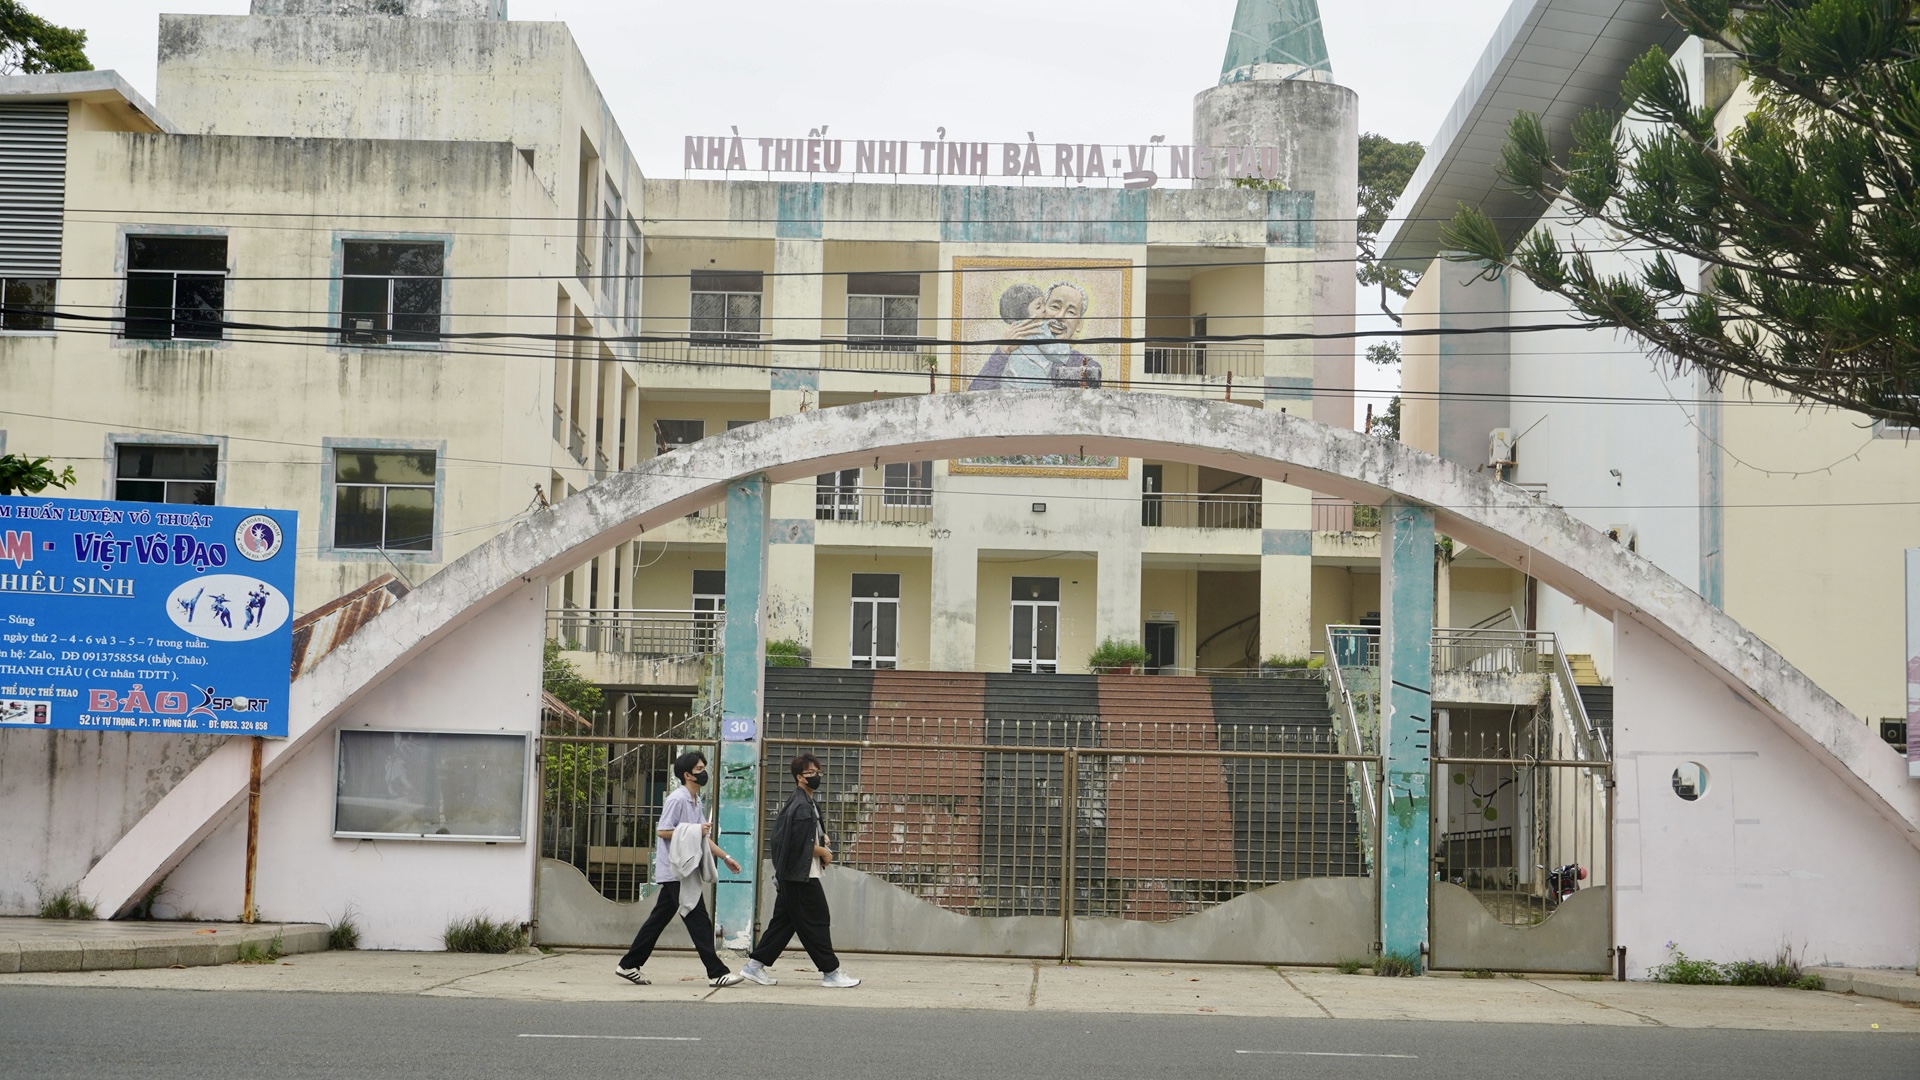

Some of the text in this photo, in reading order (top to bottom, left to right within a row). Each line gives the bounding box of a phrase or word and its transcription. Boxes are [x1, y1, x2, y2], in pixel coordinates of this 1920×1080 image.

[685, 125, 746, 170] NHÀ
[758, 125, 841, 173] THIẾU
[856, 139, 907, 174] NHI
[920, 126, 988, 175] TỈNH
[1002, 131, 1042, 177] BÀ
[16, 502, 64, 520] HUẤN
[68, 507, 124, 525] LUYỆN
[128, 509, 151, 524] VÕ
[156, 511, 213, 529] THUẬT
[134, 532, 169, 564] VÕ
[172, 534, 227, 572] ĐẠO
[73, 577, 135, 595] SINH
[9, 614, 35, 626] Súng
[4, 632, 28, 644] ngày
[32, 633, 48, 642] thứ
[51, 634, 57, 643] 2
[70, 635, 76, 643] 4
[86, 636, 92, 644] 6
[95, 636, 107, 645] và
[110, 636, 116, 645] 3
[129, 637, 135, 646] 5
[147, 638, 154, 646] 7
[156, 639, 183, 649] trong
[11, 649, 26, 660] hệ:
[29, 650, 55, 661] Zalo,
[61, 652, 79, 661] DĐ
[82, 652, 145, 663] 0913758554
[147, 653, 173, 666] (thầy
[175, 656, 208, 667] Châu).
[0, 664, 44, 676] THANH
[46, 665, 83, 677] CHÂU
[92, 668, 108, 678] Cử
[110, 669, 135, 679] nhân
[138, 670, 169, 680] TDTT
[1, 682, 79, 698] THỂ DỤC THỂ THAO
[88, 684, 188, 714] BẢO
[79, 714, 91, 726] 52
[102, 716, 112, 728] TỰ
[152, 718, 162, 727] TP.
[220, 720, 240, 730] 0933.
[241, 721, 254, 730] 324
[255, 721, 268, 731] 858
[730, 721, 748, 733] 30
